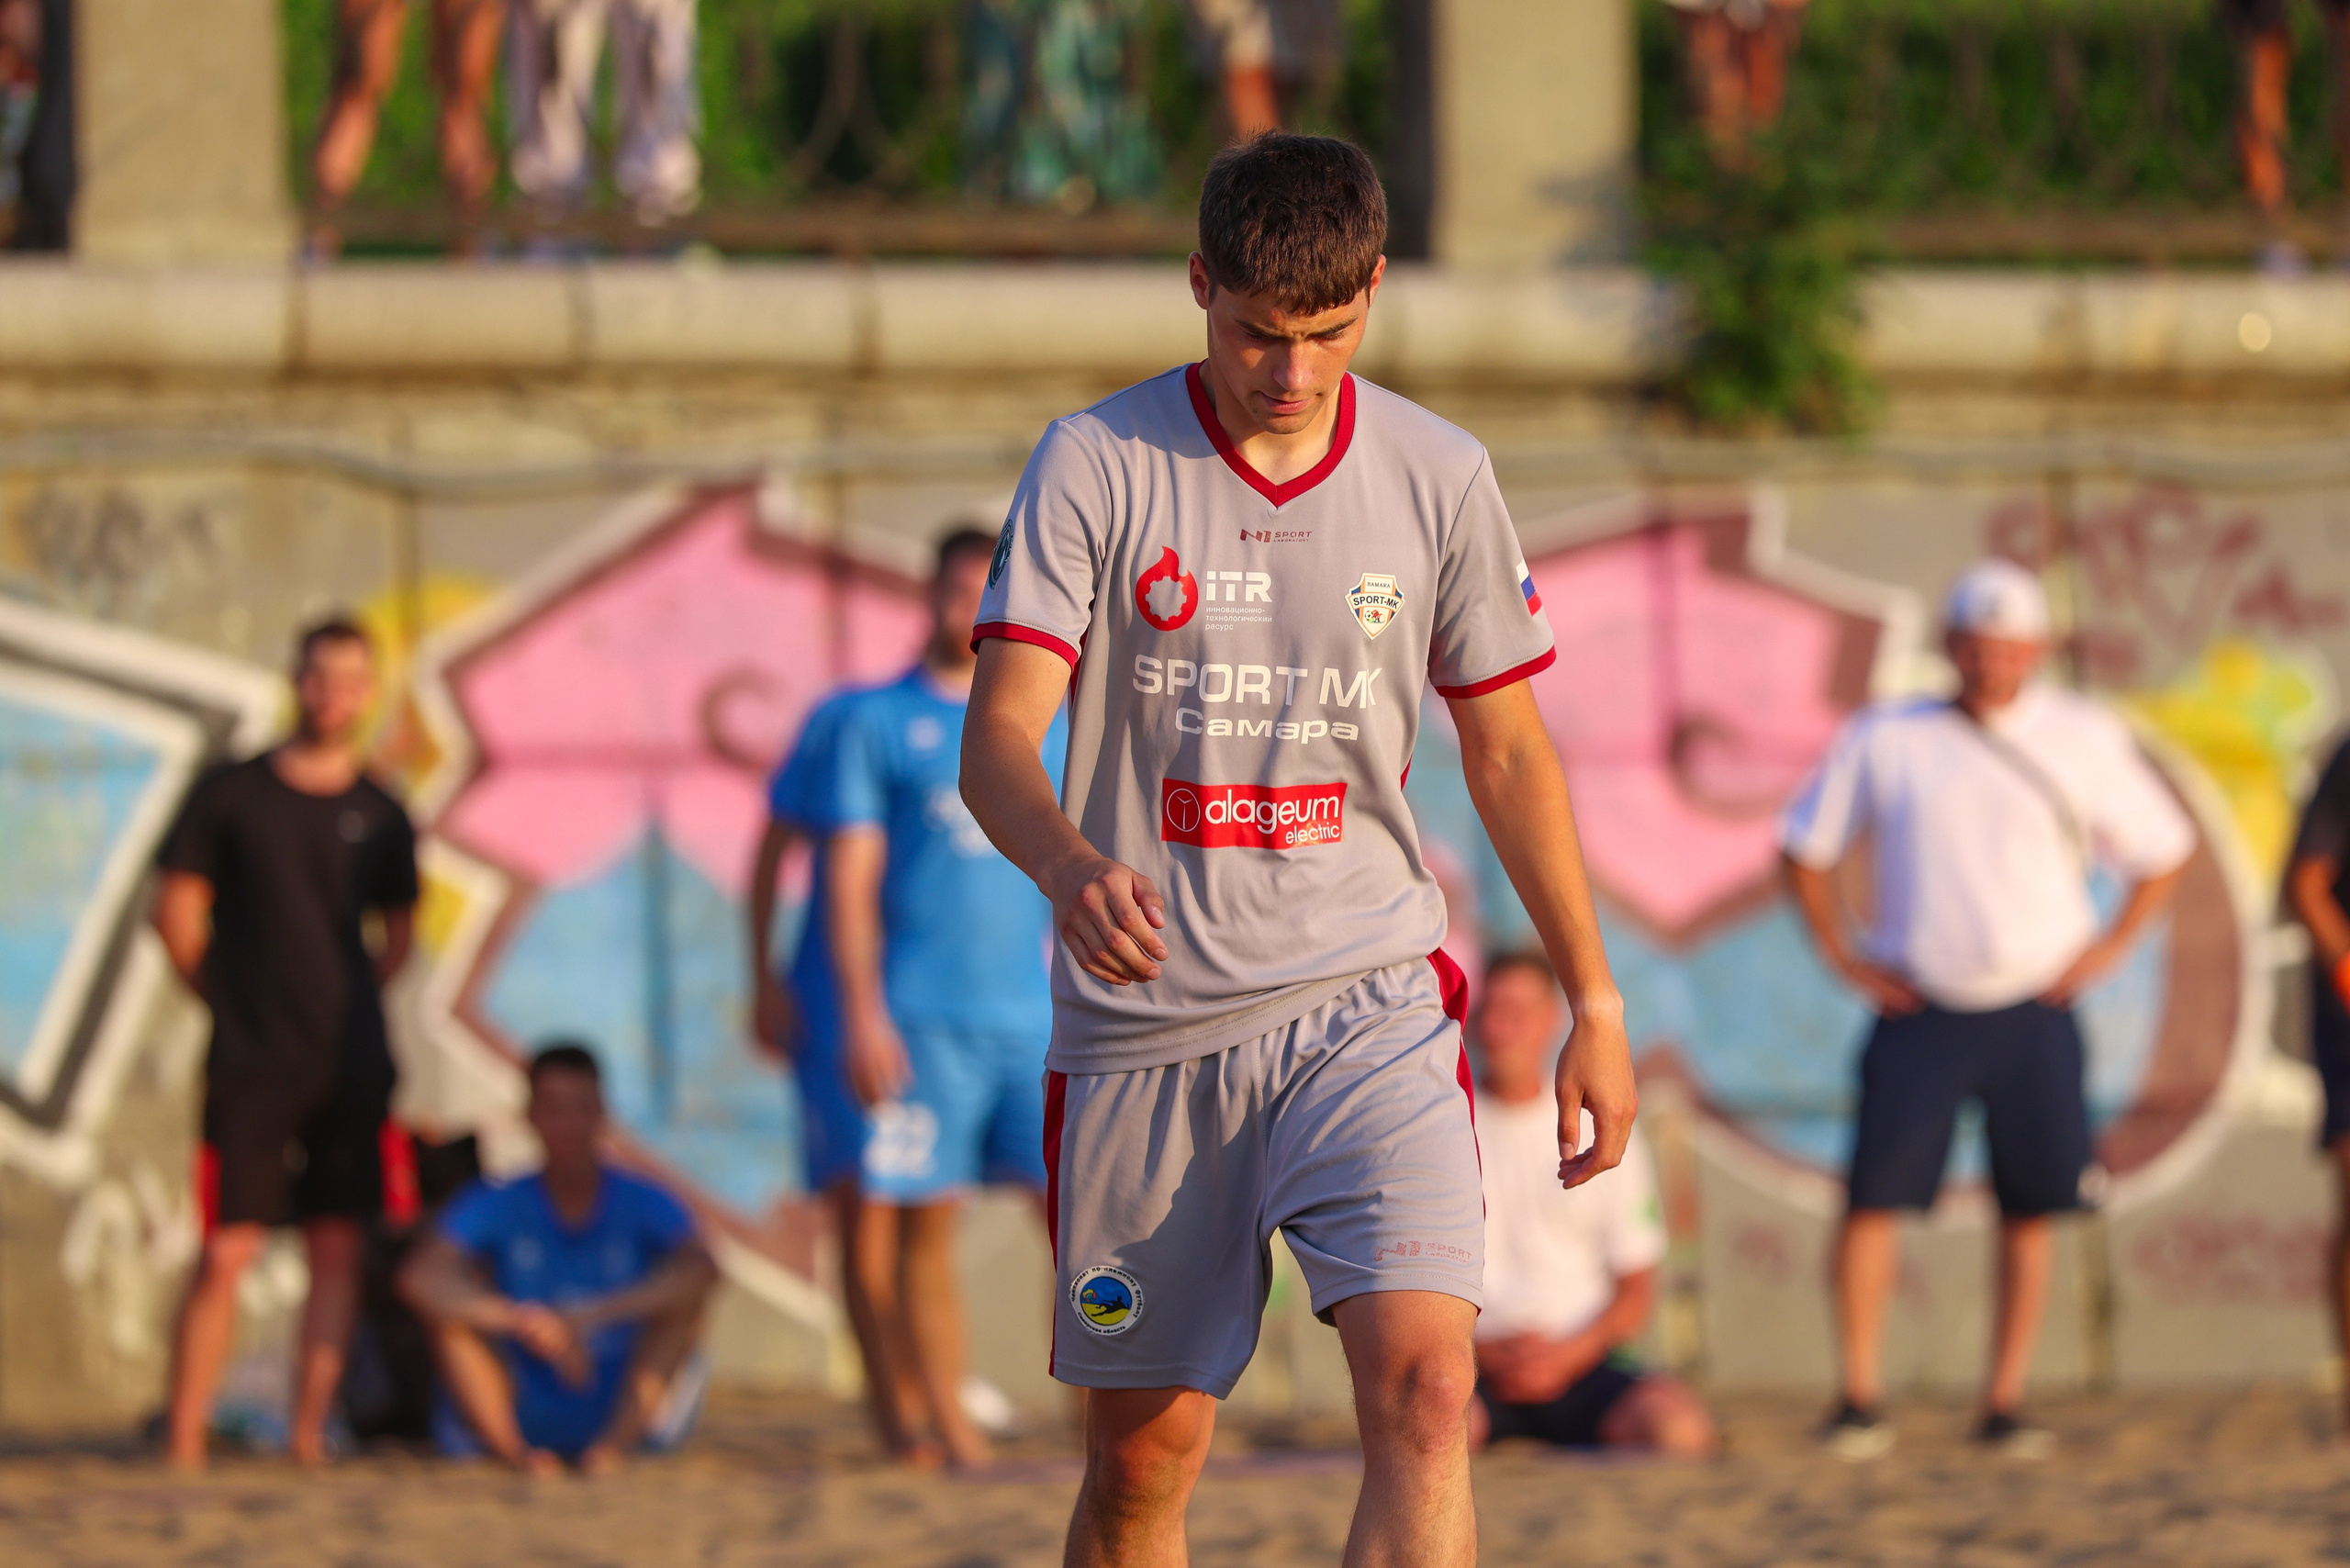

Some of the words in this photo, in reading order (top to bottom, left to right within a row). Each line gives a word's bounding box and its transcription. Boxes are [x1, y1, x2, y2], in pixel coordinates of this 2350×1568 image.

[1353, 595, 1399, 610] SPORT-MK
[1132, 654, 1308, 706] SPORT
[1319, 667, 1382, 709] MK
[1175, 707, 1360, 745] Самара
[1205, 789, 1339, 834] alageum
[1285, 823, 1340, 845] electric
[1427, 1242, 1472, 1260] SPORT
